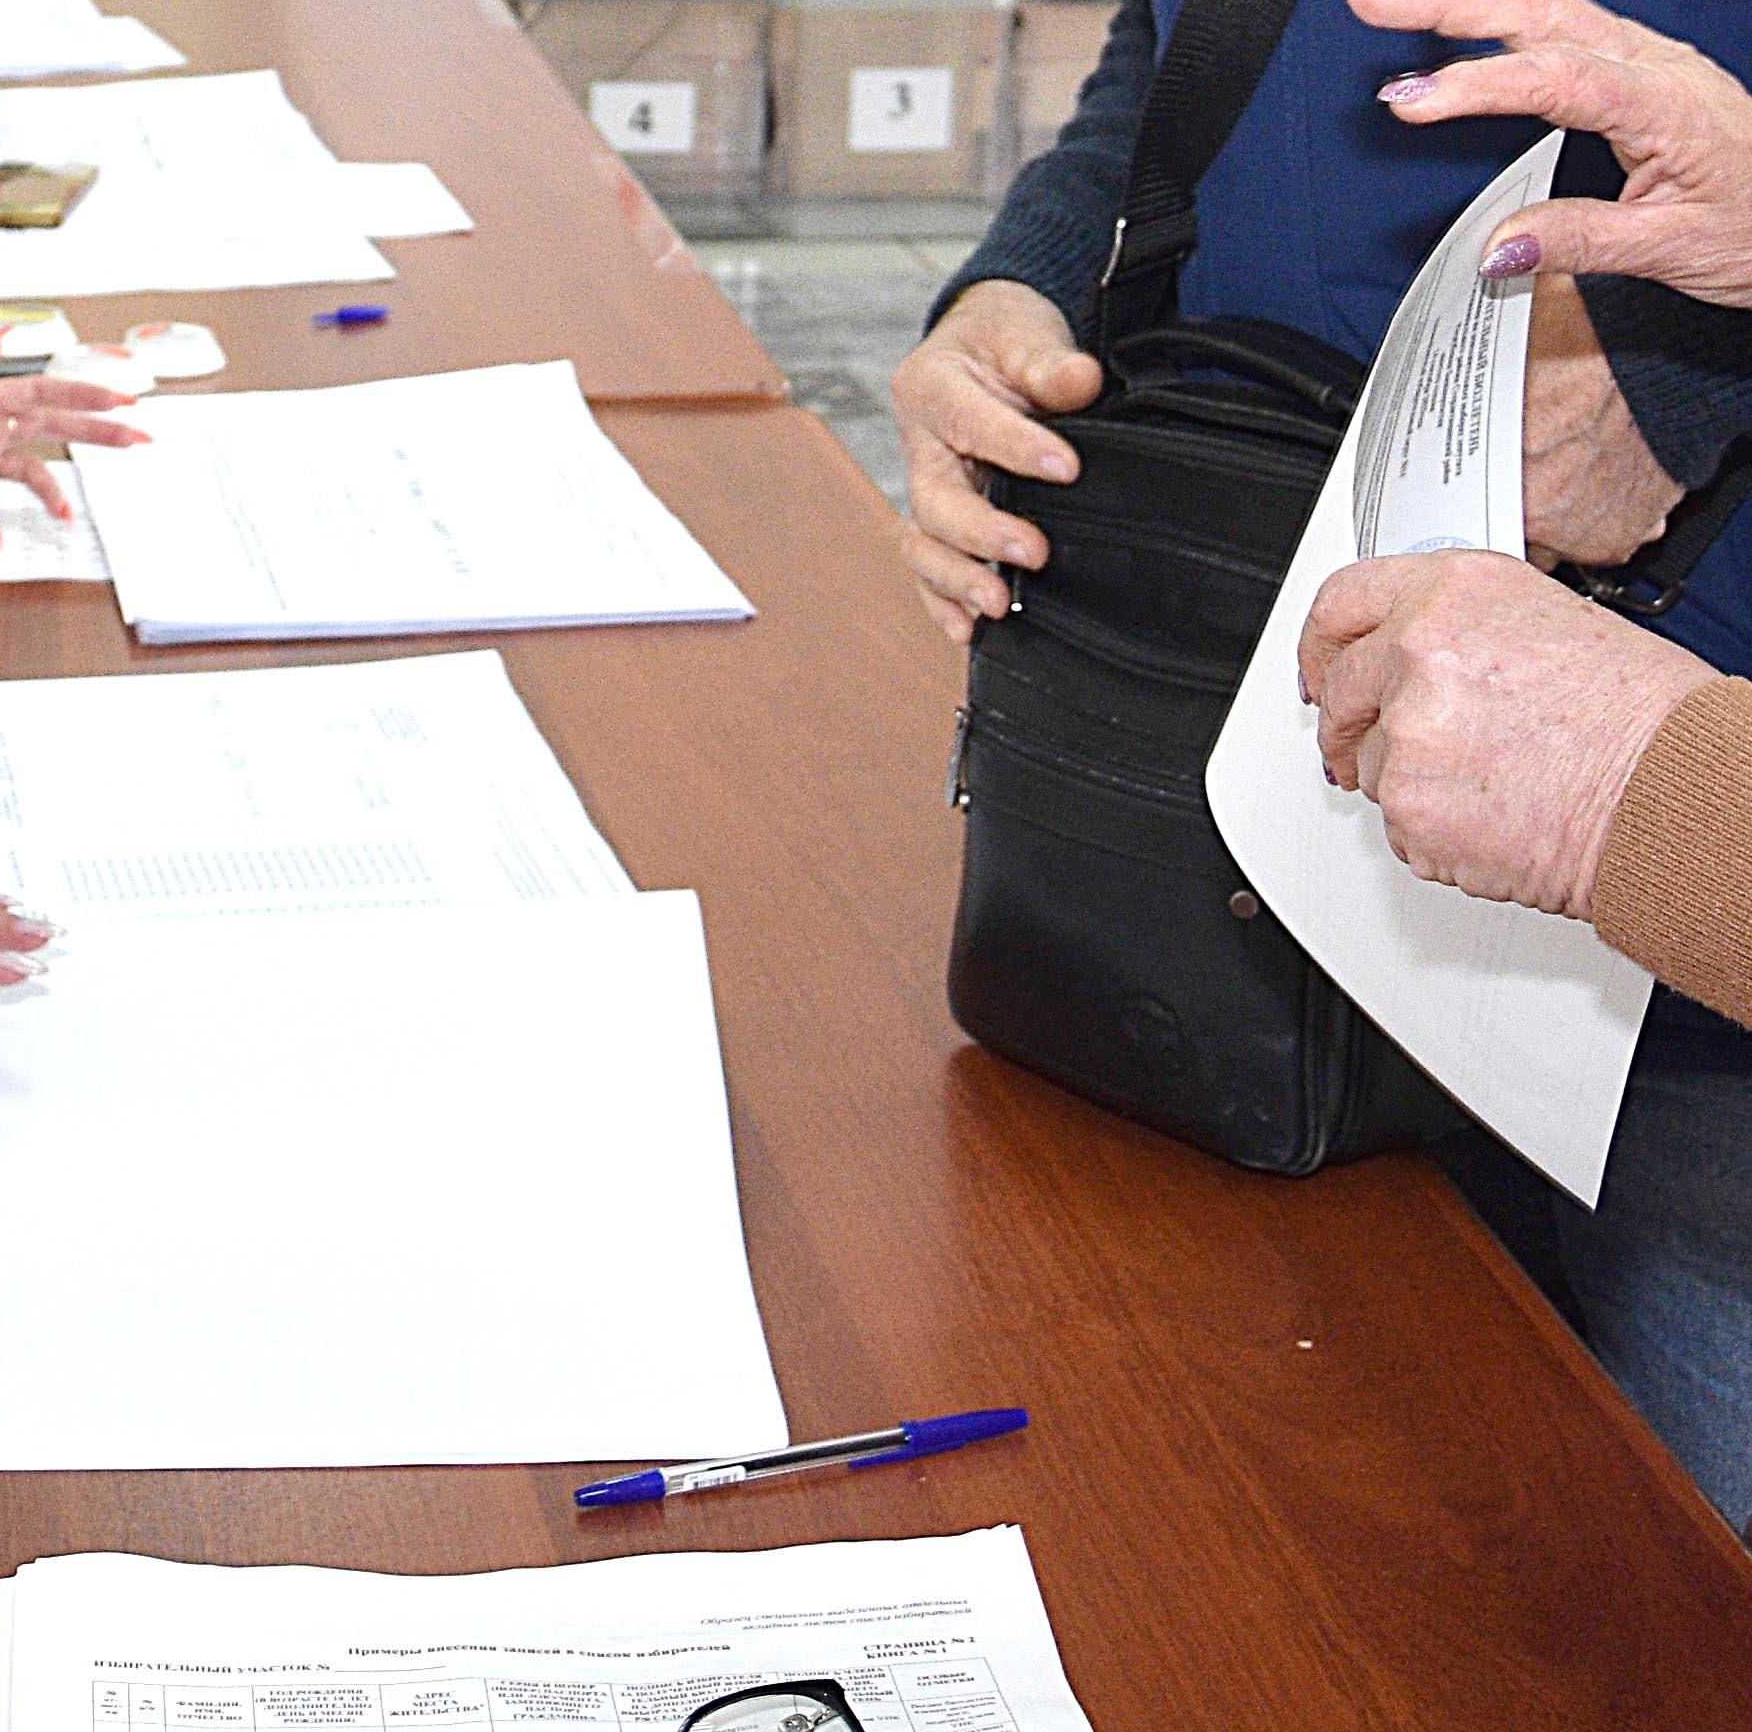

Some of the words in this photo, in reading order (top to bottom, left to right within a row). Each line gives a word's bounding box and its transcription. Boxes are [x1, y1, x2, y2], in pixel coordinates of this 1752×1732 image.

[627, 102, 654, 134] 4
[348, 1648, 422, 1657] Примеры
[637, 1644, 731, 1657] избирателей
[863, 1641, 947, 1652] СТРАНИЦА
[867, 1650, 919, 1660] КНИГА
[94, 1659, 232, 1674] ИЗБИРАТЕЛЬНЫЙ
[237, 1664, 311, 1674] УЧАСТОК
